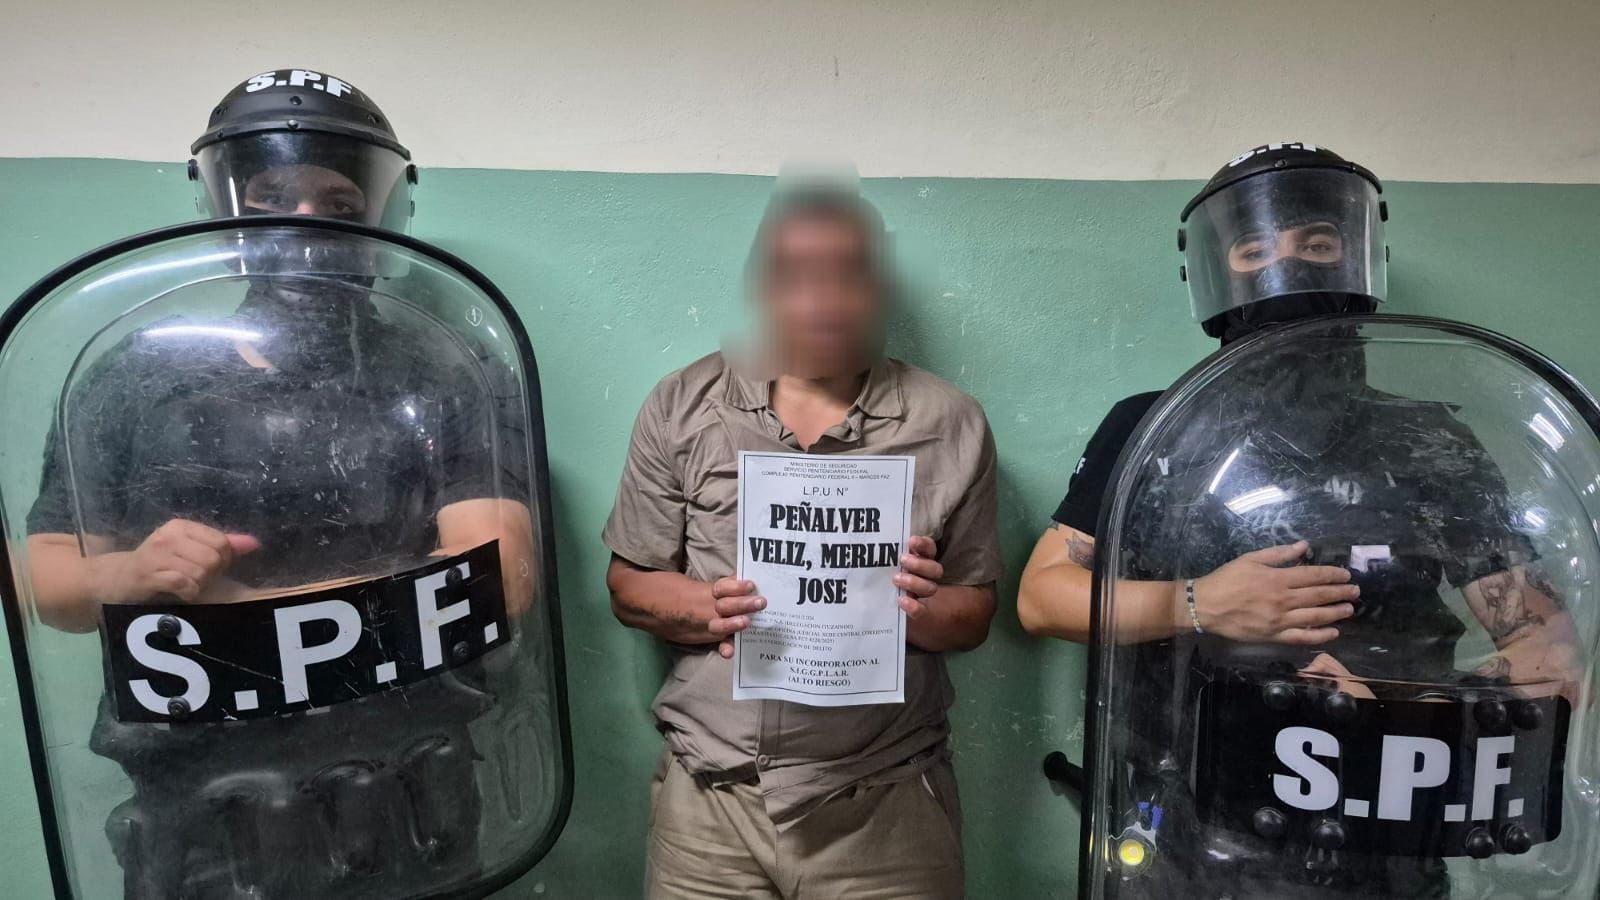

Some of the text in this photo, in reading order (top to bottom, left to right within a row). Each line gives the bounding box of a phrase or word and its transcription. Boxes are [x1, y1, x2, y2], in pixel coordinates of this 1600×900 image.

[769, 501, 881, 534] PEÑALVER
[748, 537, 900, 571] VELIZ, MERLIN
[796, 577, 847, 605] JOSE
[126, 562, 500, 716] S.P.F.
[759, 653, 880, 668] PARA SU INCORPORACION AL
[788, 676, 850, 687] (ALTO RIESGO)
[1273, 726, 1525, 822] S.P.F.
